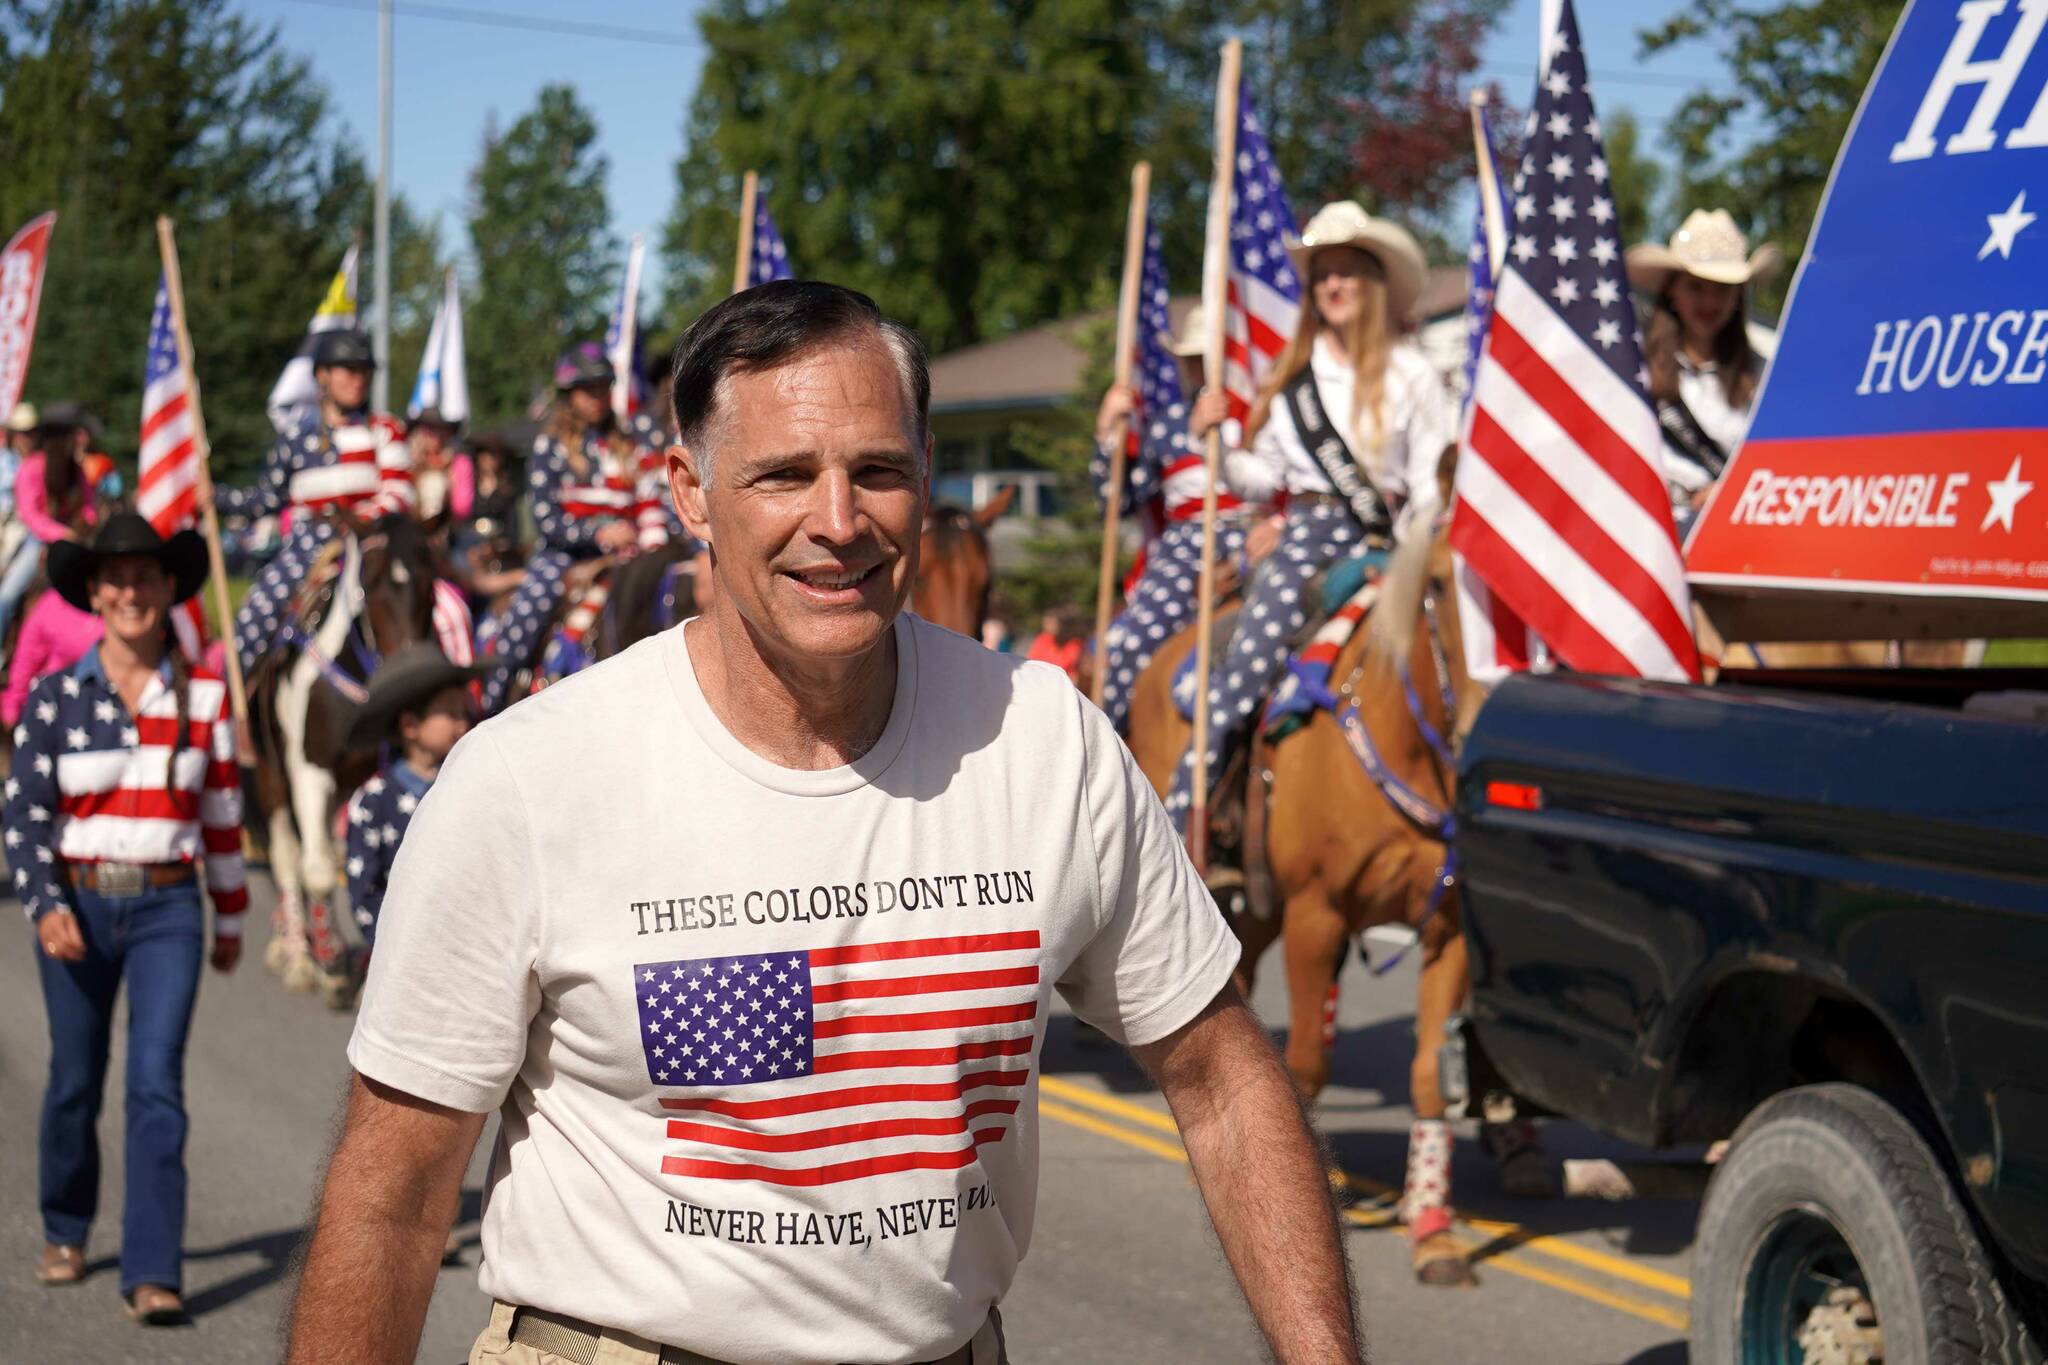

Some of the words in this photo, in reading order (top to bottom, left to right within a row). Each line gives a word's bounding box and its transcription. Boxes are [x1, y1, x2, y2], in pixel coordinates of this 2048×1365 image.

[1856, 310, 2048, 395] HOUSE
[631, 894, 737, 935] THESE
[744, 882, 868, 924] COLORS
[874, 875, 967, 914] DON'T
[974, 870, 1034, 905] RUN
[665, 1200, 766, 1244] NEVER
[775, 1211, 872, 1249] HAVE,
